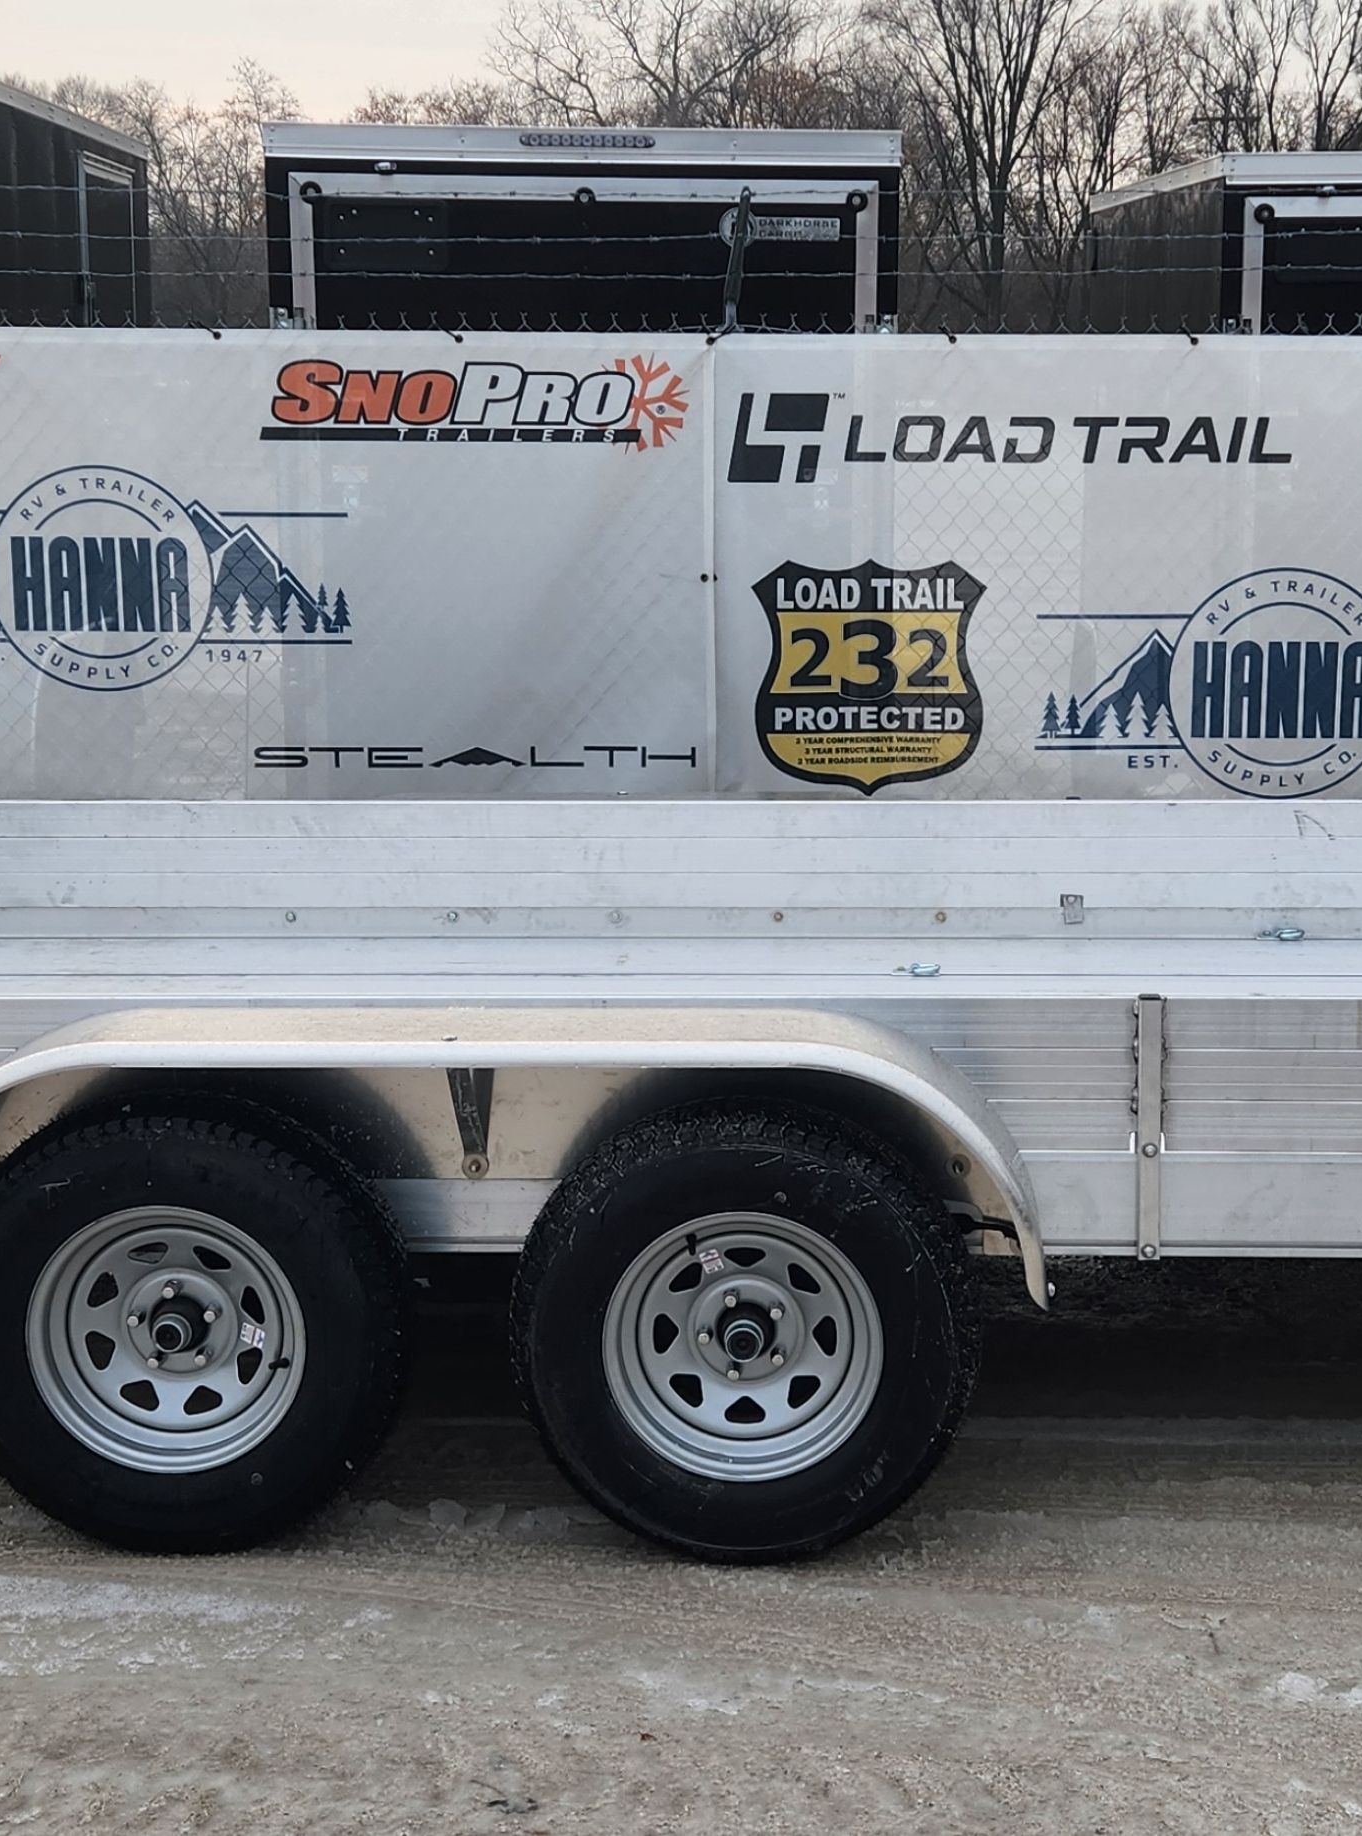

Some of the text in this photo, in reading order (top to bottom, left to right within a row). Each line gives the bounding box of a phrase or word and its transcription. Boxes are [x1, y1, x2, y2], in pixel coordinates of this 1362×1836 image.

[397, 428, 616, 442] TRAILERS
[844, 415, 1293, 464] LOAD TRAIL
[20, 478, 175, 522] RV & TRAILER
[10, 536, 191, 632] HANNA
[776, 578, 965, 610] LOAD TRAIL
[1206, 600, 1230, 625] RV
[1245, 587, 1257, 599] &
[34, 643, 179, 679] SUPPLY CO.
[205, 650, 263, 662] 1947
[788, 618, 950, 700] 232
[774, 706, 965, 731] PROTECTED
[826, 736, 894, 744] COMPREHENSIVE
[896, 736, 941, 744] WARRANTY
[835, 746, 885, 754] STRUCTURAL
[254, 746, 697, 768] STEALTH
[805, 757, 826, 765] YEAR
[1127, 755, 1179, 769] EST.
[1208, 750, 1357, 787] SUPPLY CO.
